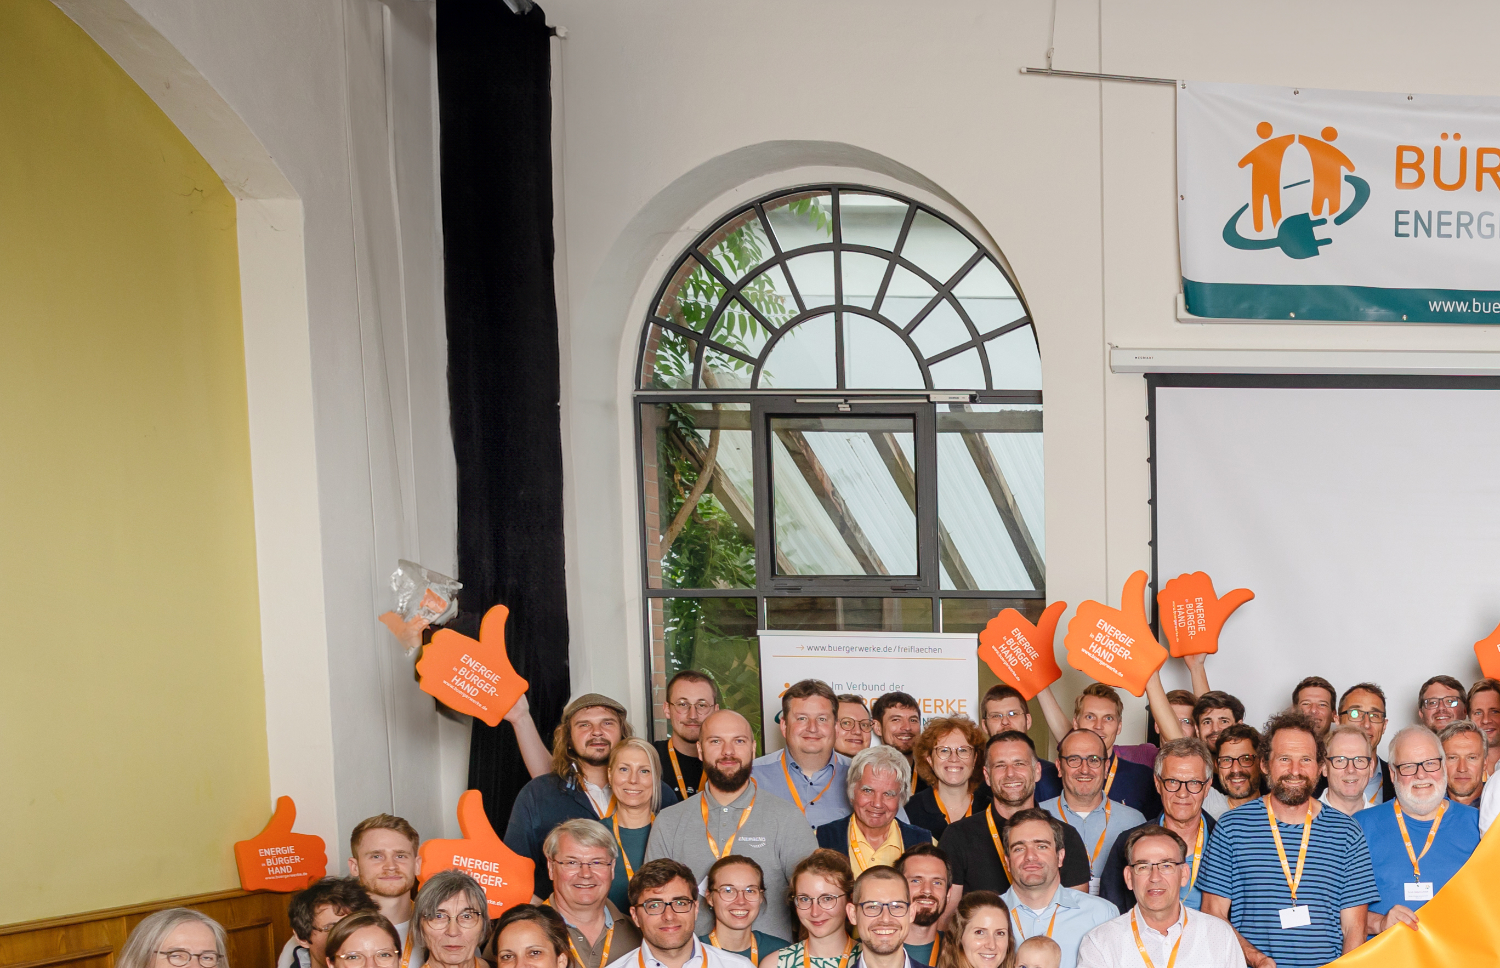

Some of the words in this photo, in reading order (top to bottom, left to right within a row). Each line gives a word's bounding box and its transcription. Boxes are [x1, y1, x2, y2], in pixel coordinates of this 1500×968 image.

[1176, 604, 1186, 628] HAND
[1186, 603, 1196, 640] BÜRGER-
[1195, 597, 1206, 632] ENERGIE
[1010, 627, 1040, 661] ENERGIE
[1095, 618, 1135, 648] ENERGIE
[998, 643, 1018, 667] HAND
[1006, 637, 1033, 672] BÜRGER-
[1088, 641, 1115, 664] HAND
[1094, 632, 1133, 661] BÜRGER-
[460, 653, 502, 685] ENERGIE
[450, 675, 480, 697] HAND
[457, 666, 500, 697] BÜRGER-
[831, 682, 844, 691] Im
[846, 682, 886, 692] Verbund
[888, 682, 905, 692] der
[258, 845, 296, 857] ENERGIE
[265, 855, 304, 867] BÜRGER-
[267, 865, 293, 875] HAND
[452, 854, 500, 874] ENERGIE
